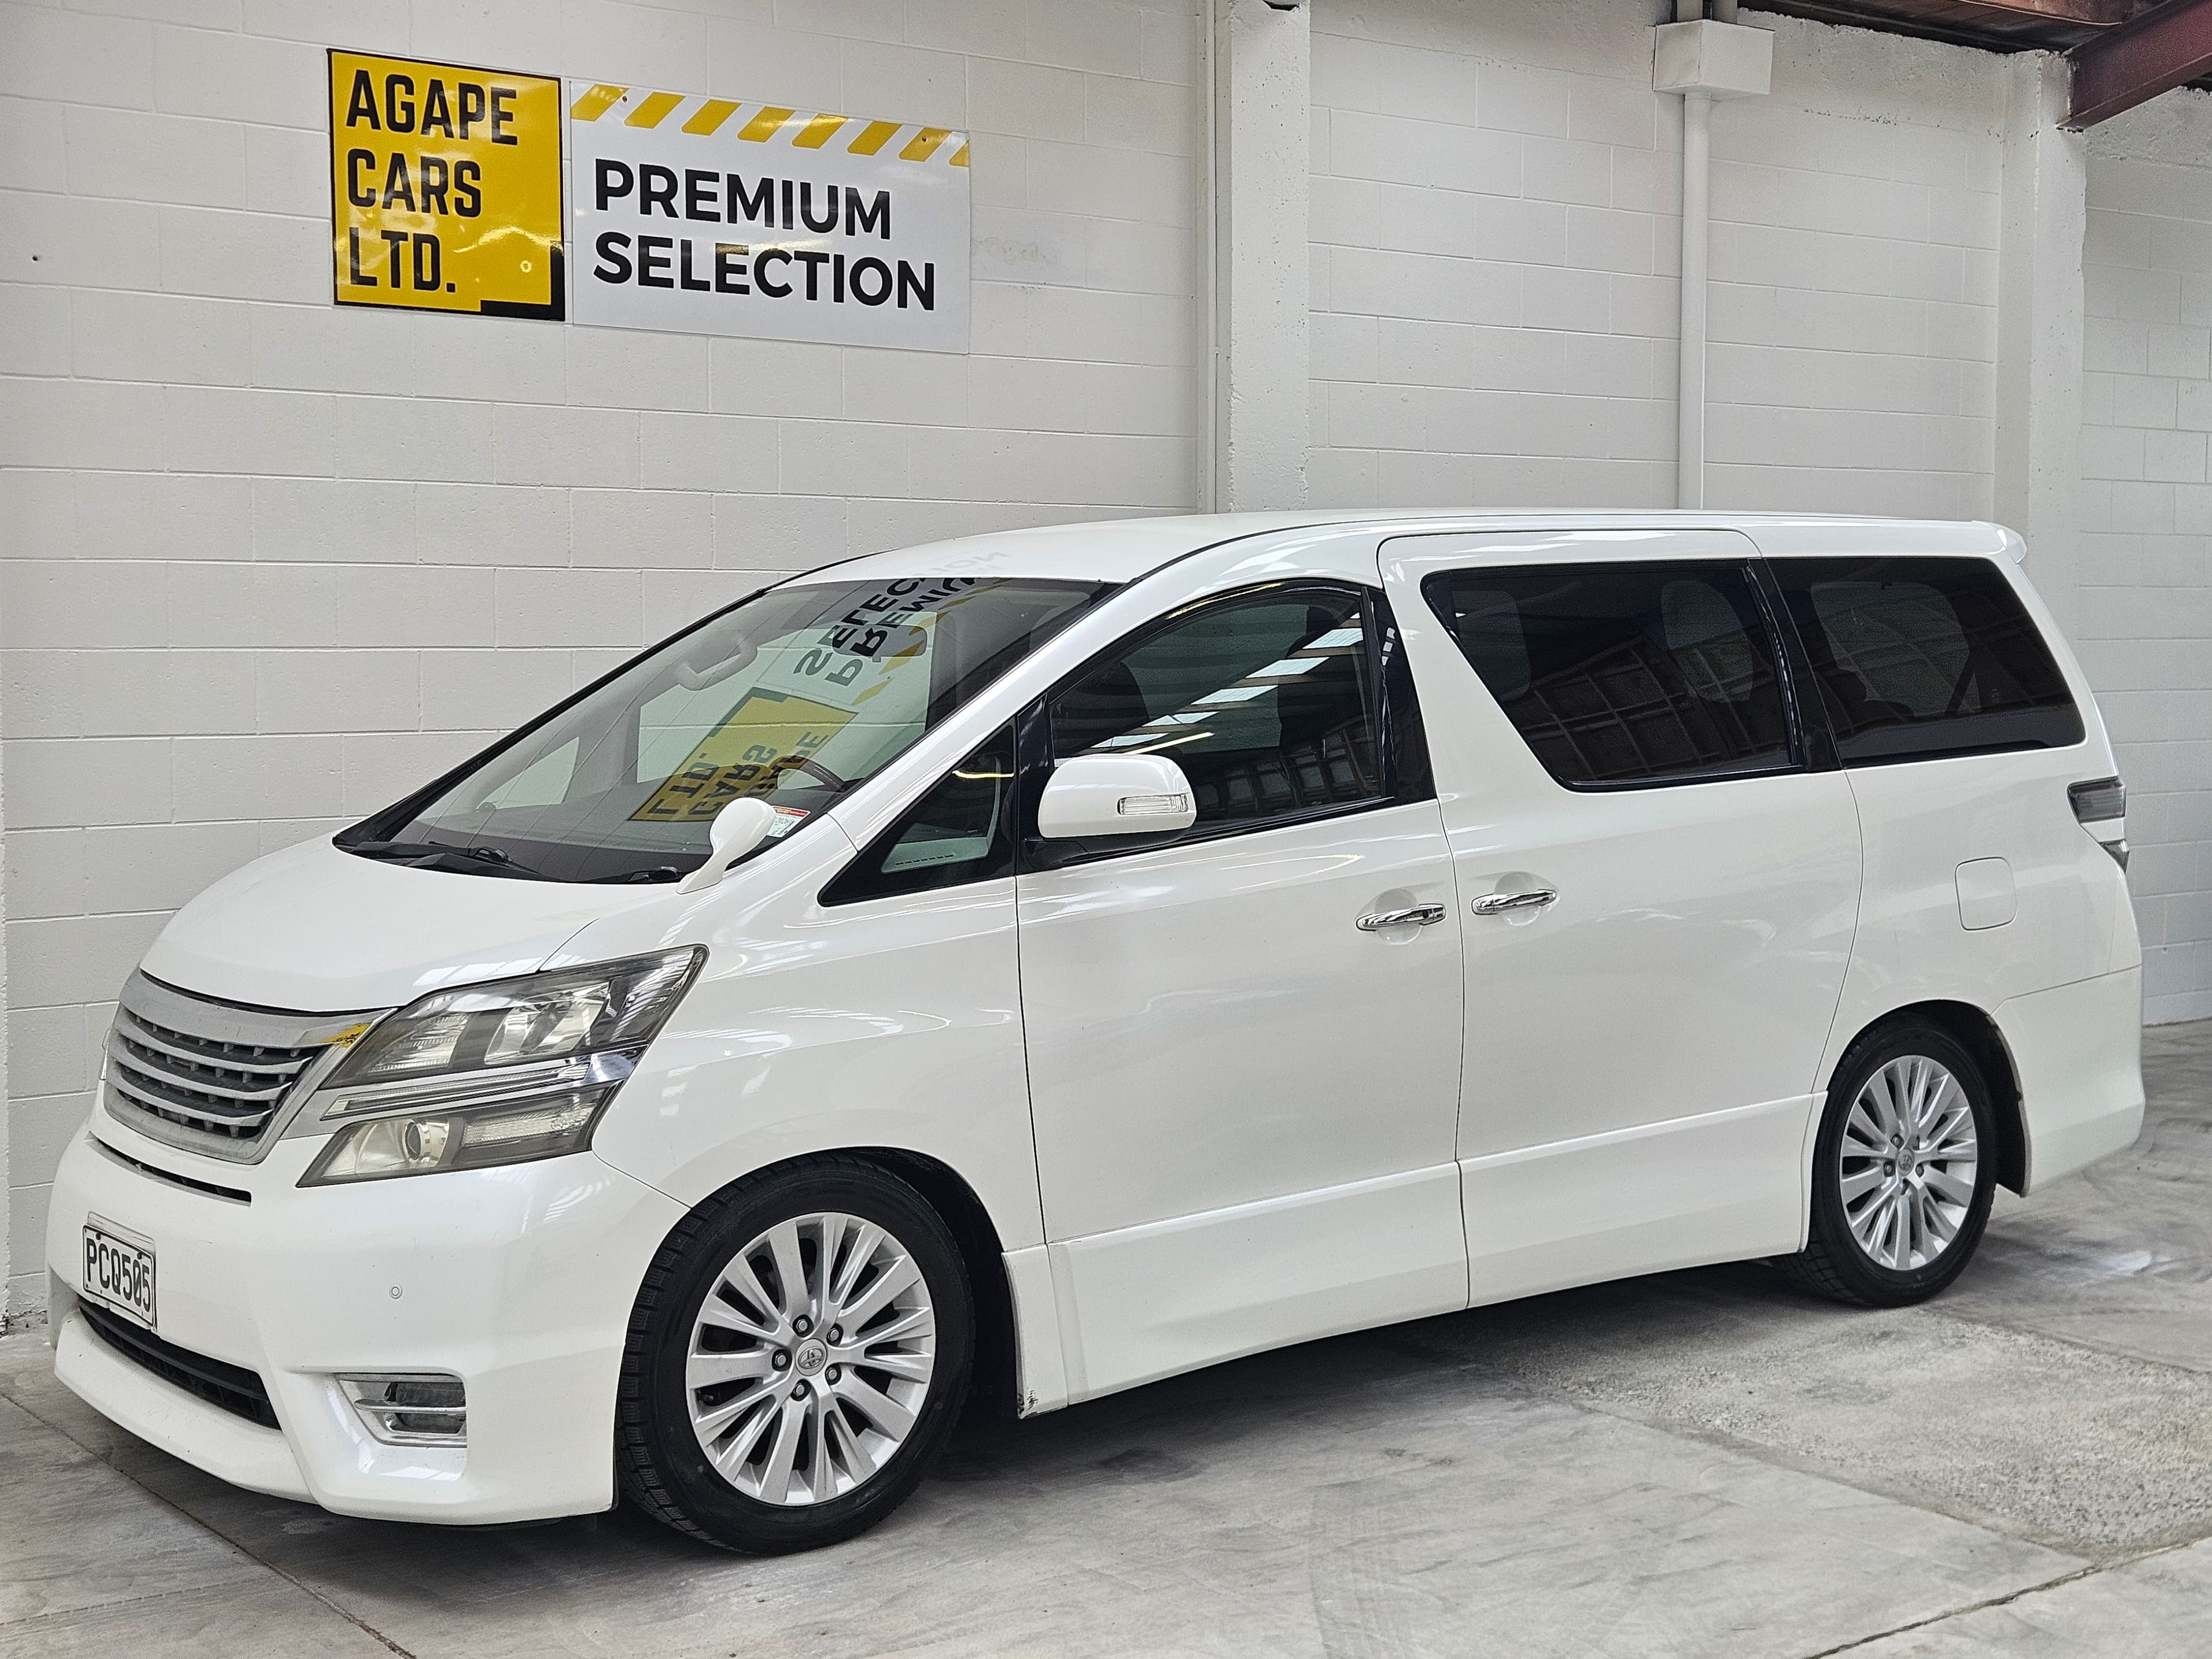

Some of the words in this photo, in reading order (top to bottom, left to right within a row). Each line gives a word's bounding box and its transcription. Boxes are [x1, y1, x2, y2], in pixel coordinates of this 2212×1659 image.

[346, 70, 517, 145] AGAPE
[347, 149, 480, 217] CARS
[595, 158, 890, 240] PREMIUM
[349, 227, 456, 293] LTD.
[593, 232, 934, 310] SELECTION
[86, 1238, 150, 1312] PCQ505
